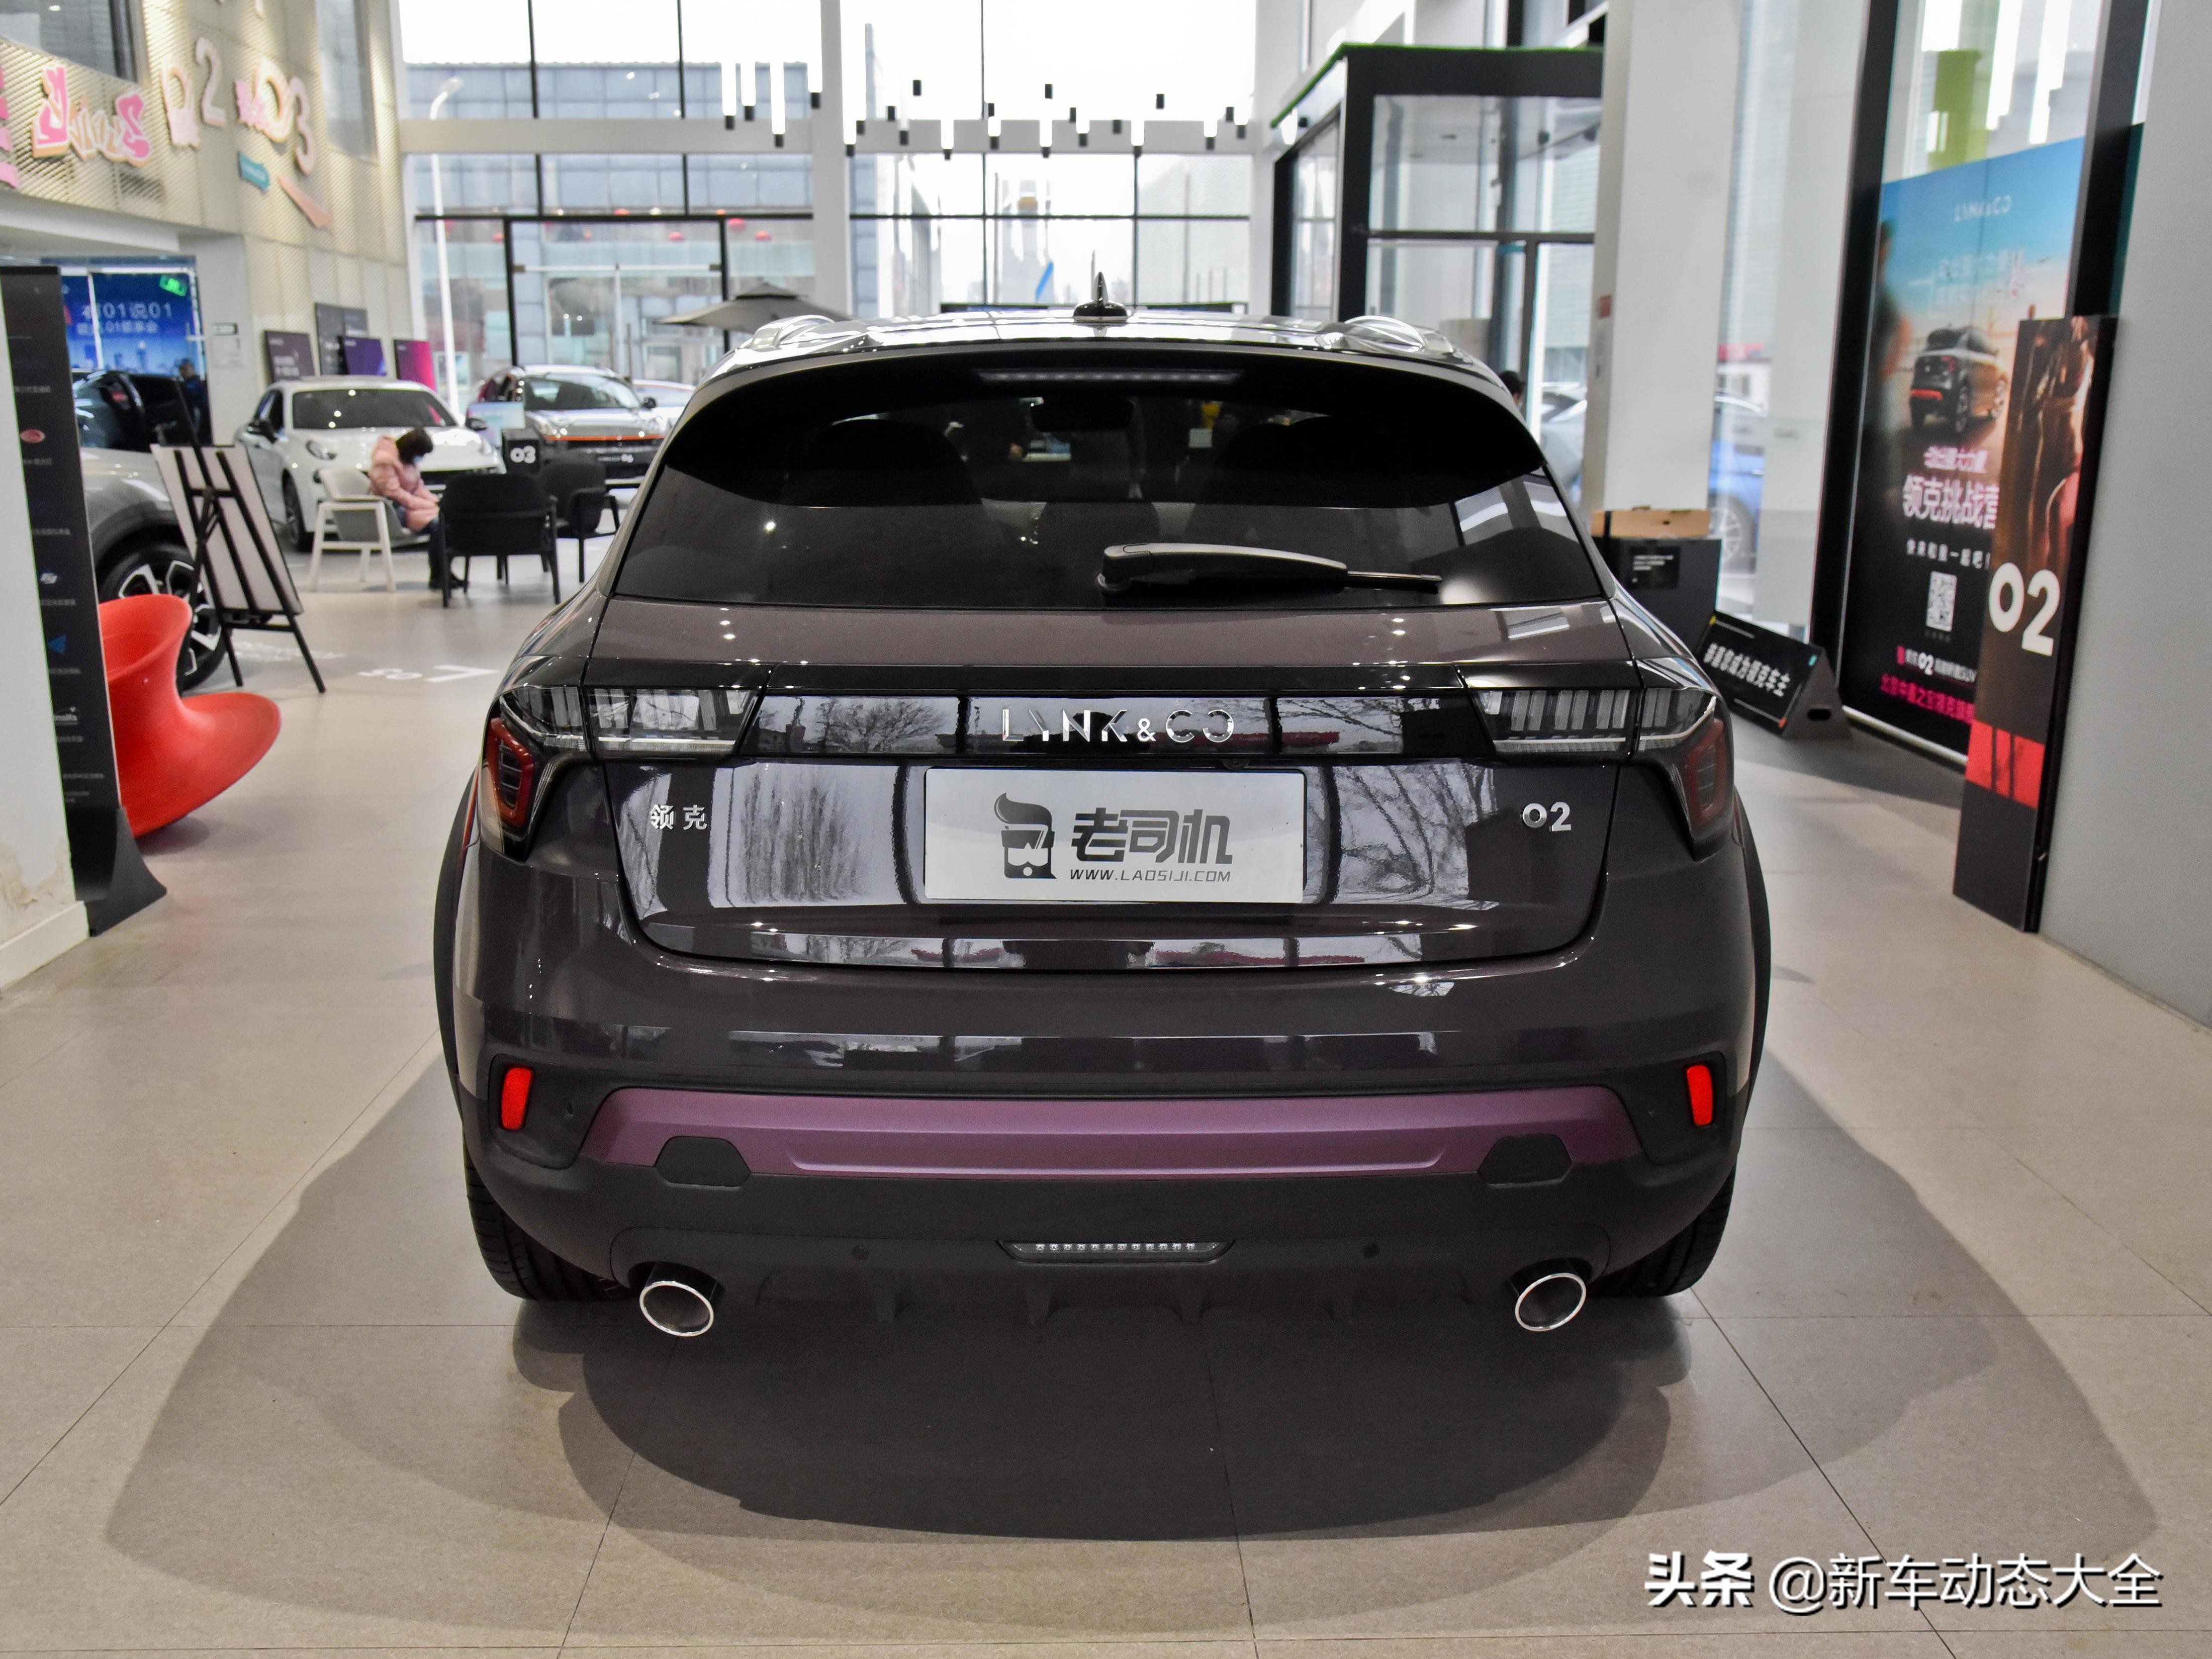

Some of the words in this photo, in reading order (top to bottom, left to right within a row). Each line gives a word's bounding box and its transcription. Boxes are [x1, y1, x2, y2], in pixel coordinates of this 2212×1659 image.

[510, 445, 536, 464] 03
[1989, 562, 2060, 657] 02
[1002, 708, 1235, 743] LYNK&CO
[650, 804, 708, 831] 领克
[1522, 801, 1572, 832] 02
[1071, 807, 1233, 865] 老司机
[1070, 869, 1232, 883] WWW.LAOSIJI.COM
